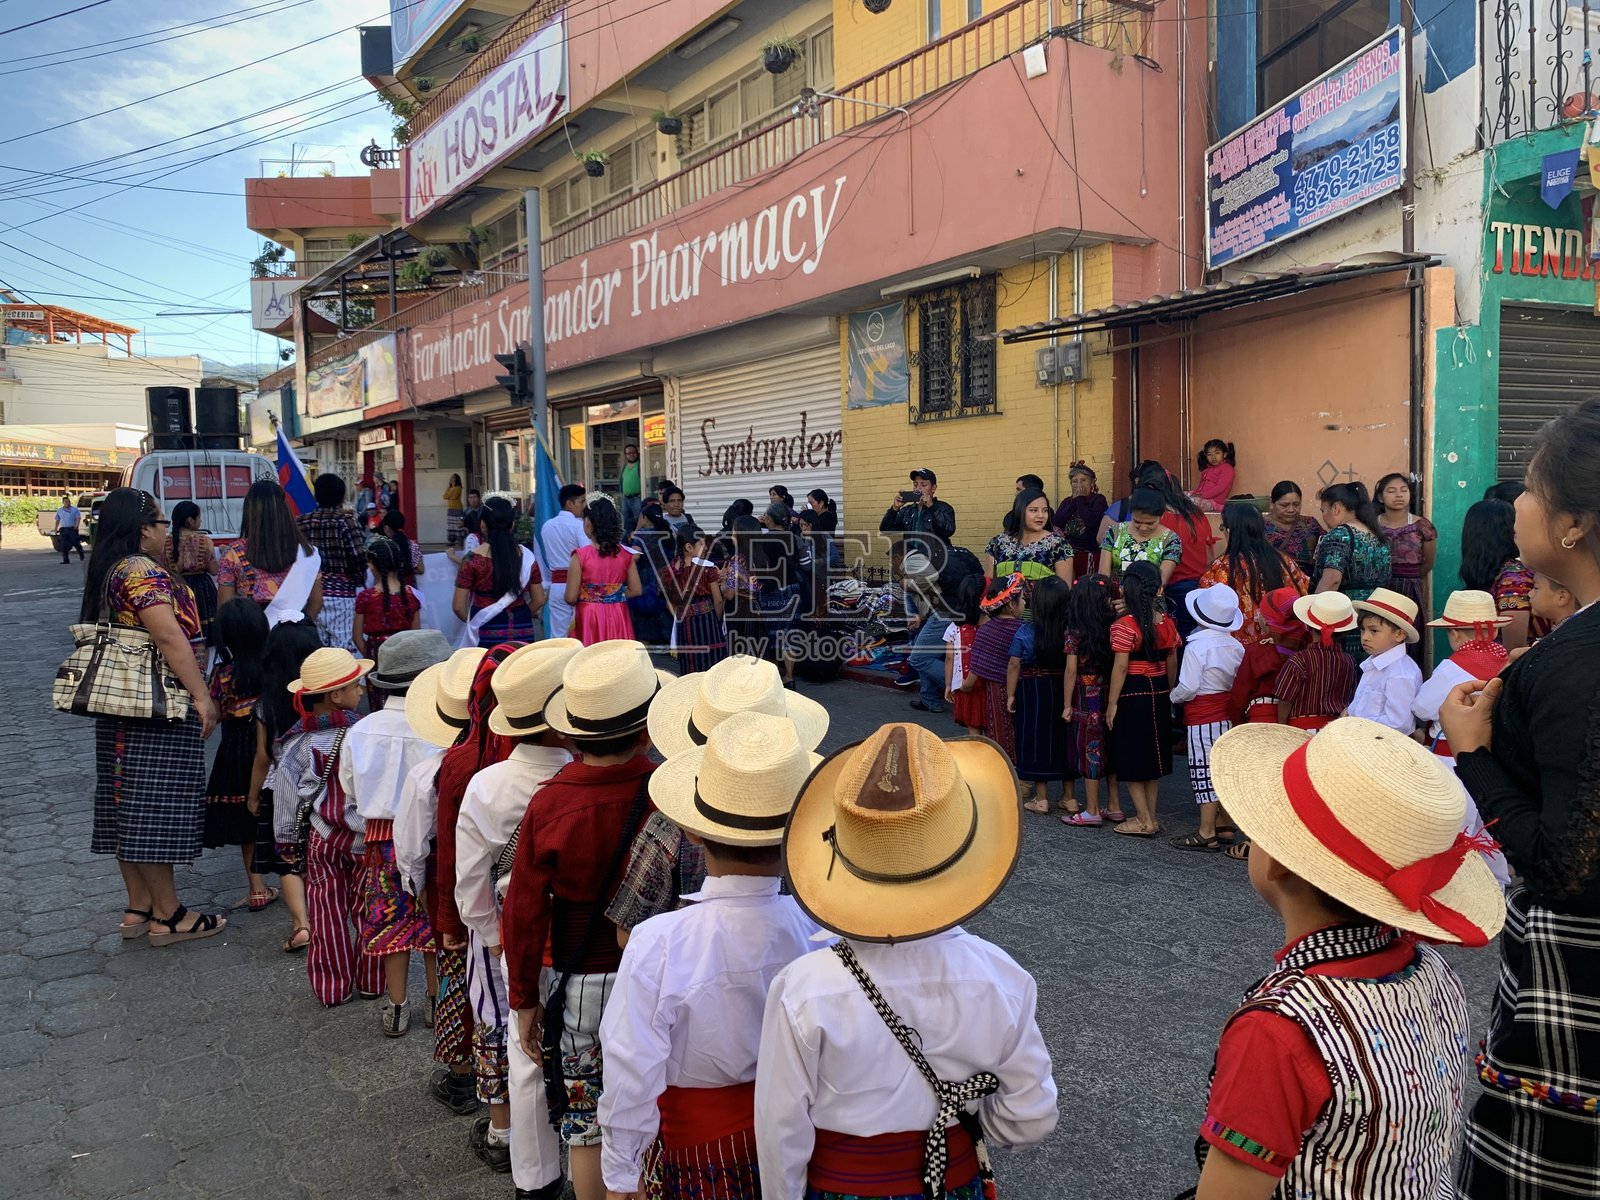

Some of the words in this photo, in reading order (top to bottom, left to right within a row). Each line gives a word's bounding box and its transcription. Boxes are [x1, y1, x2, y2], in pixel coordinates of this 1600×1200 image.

[1293, 101, 1322, 134] ORILLA
[1321, 92, 1335, 118] DE
[1335, 78, 1361, 110] LAGO
[1361, 51, 1399, 92] ATITLAN
[1300, 81, 1327, 111] VENTA
[1328, 77, 1341, 96] DE
[1342, 40, 1390, 89] TERRENOS
[444, 49, 554, 184] HOSTAL
[1294, 124, 1399, 194] 4770-2158
[1295, 147, 1399, 215] 5826-2725
[1547, 168, 1571, 179] ELIGE
[411, 314, 492, 384] Farmacia
[498, 259, 620, 353] Sanander
[630, 175, 847, 317] Pharmacy
[699, 411, 842, 477] Santander
